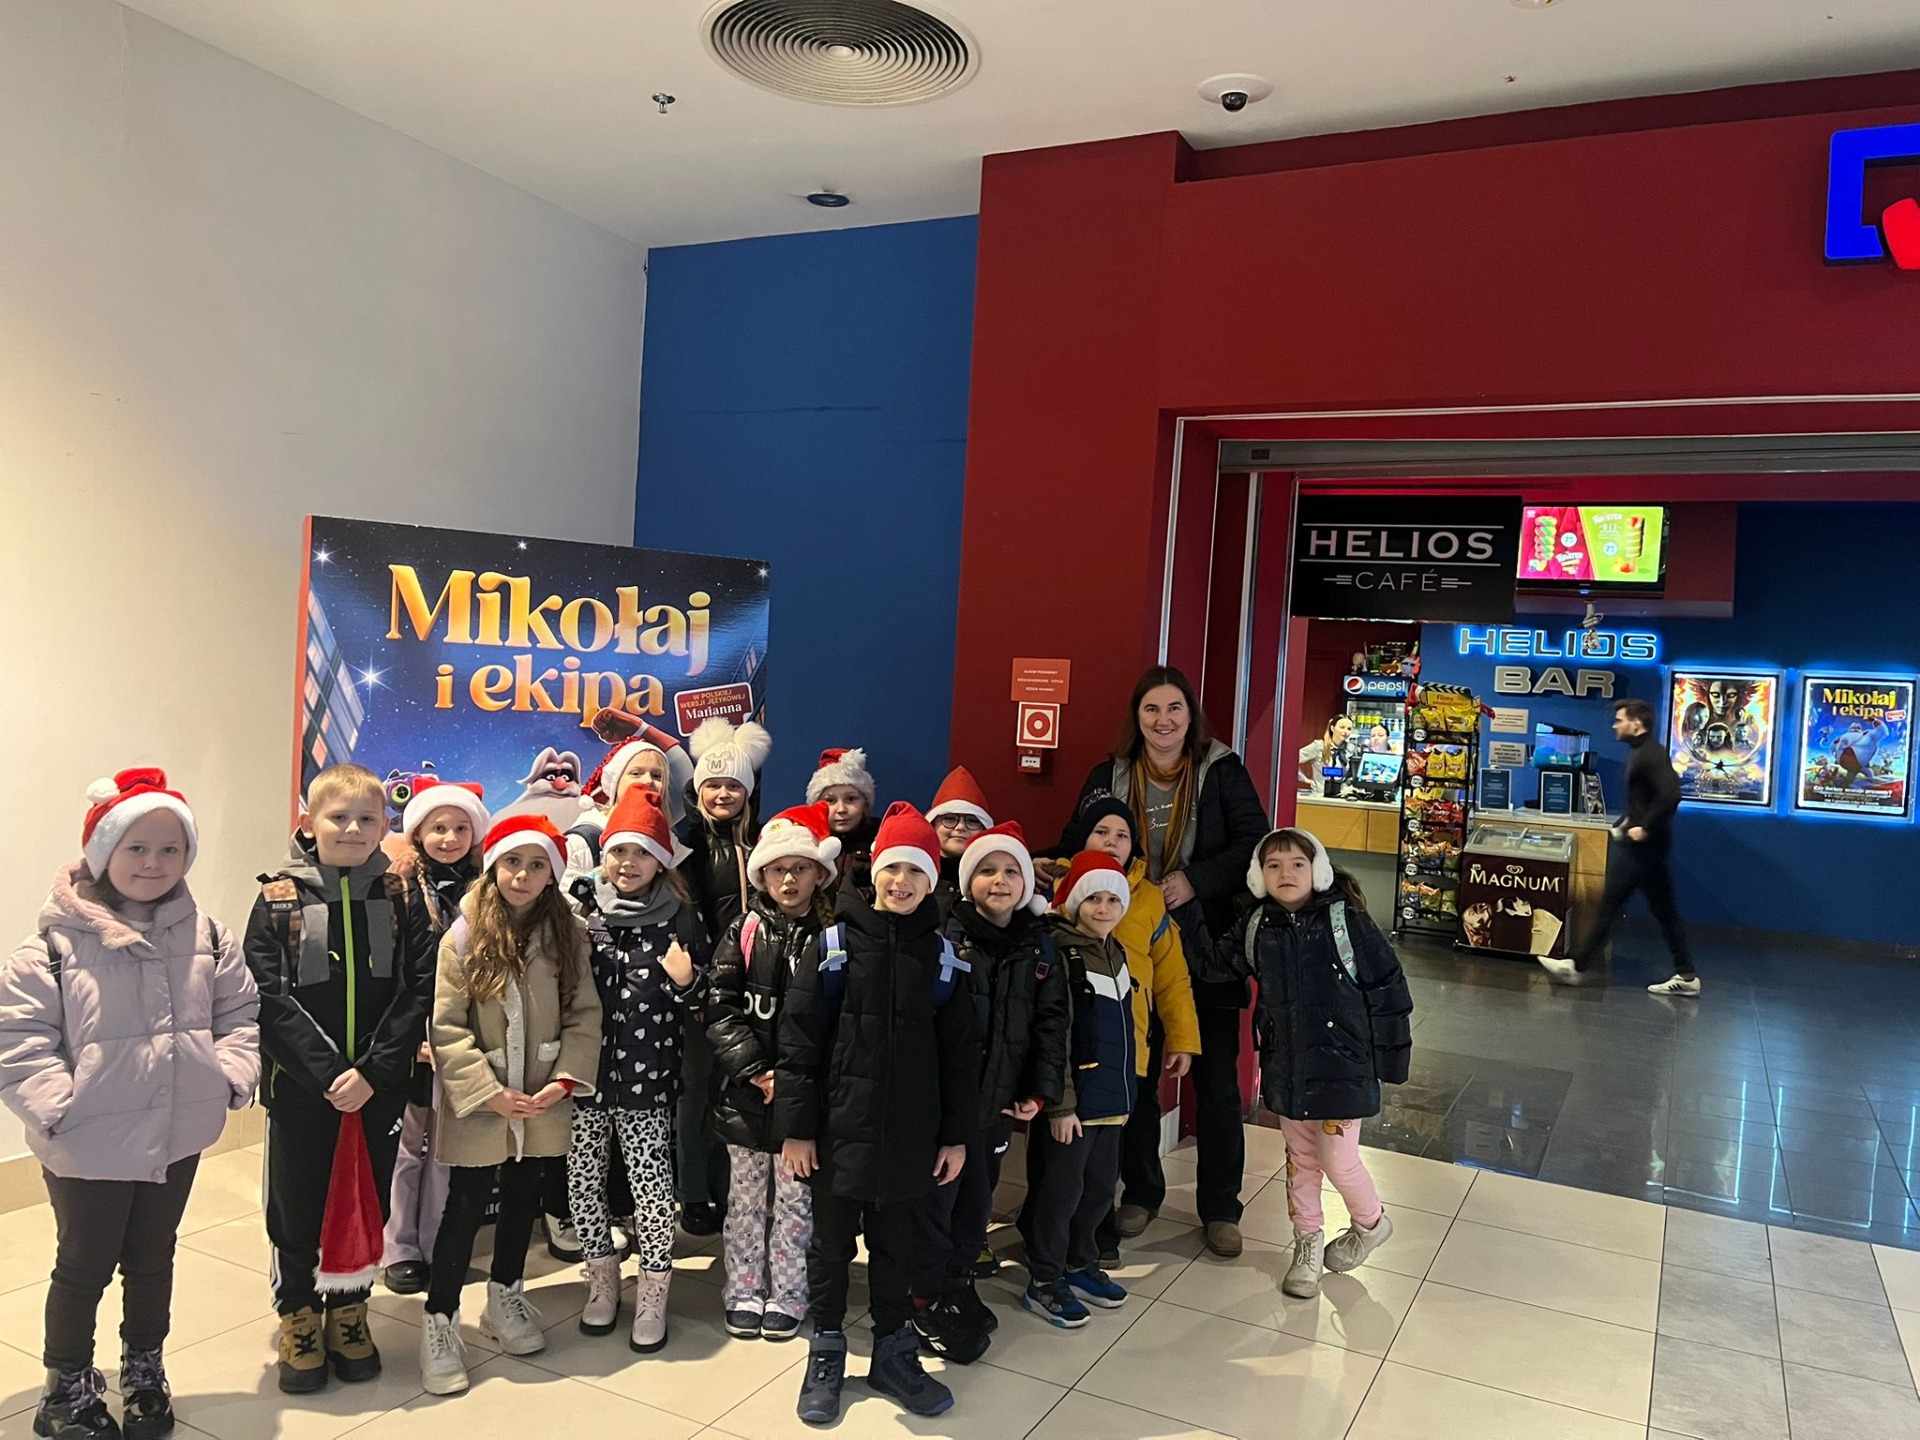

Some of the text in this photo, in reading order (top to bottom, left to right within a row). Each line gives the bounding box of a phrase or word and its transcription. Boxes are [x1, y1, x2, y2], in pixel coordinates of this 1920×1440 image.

[1309, 530, 1495, 560] HELIOS
[1355, 569, 1437, 592] CAFÉ
[385, 563, 711, 676] Mikołaj
[1459, 628, 1657, 660] HELIOS
[434, 653, 666, 728] i ekipa
[1367, 680, 1406, 693] pepsi
[1494, 665, 1616, 699] BAR
[679, 700, 706, 709] WERSJI
[701, 689, 732, 699] POLSKIEJ
[1823, 688, 1897, 709] Mikołaj
[685, 703, 742, 720] Marianna
[1840, 705, 1884, 720] ekipa
[711, 760, 721, 769] M
[1469, 867, 1560, 893] MAGNUM
